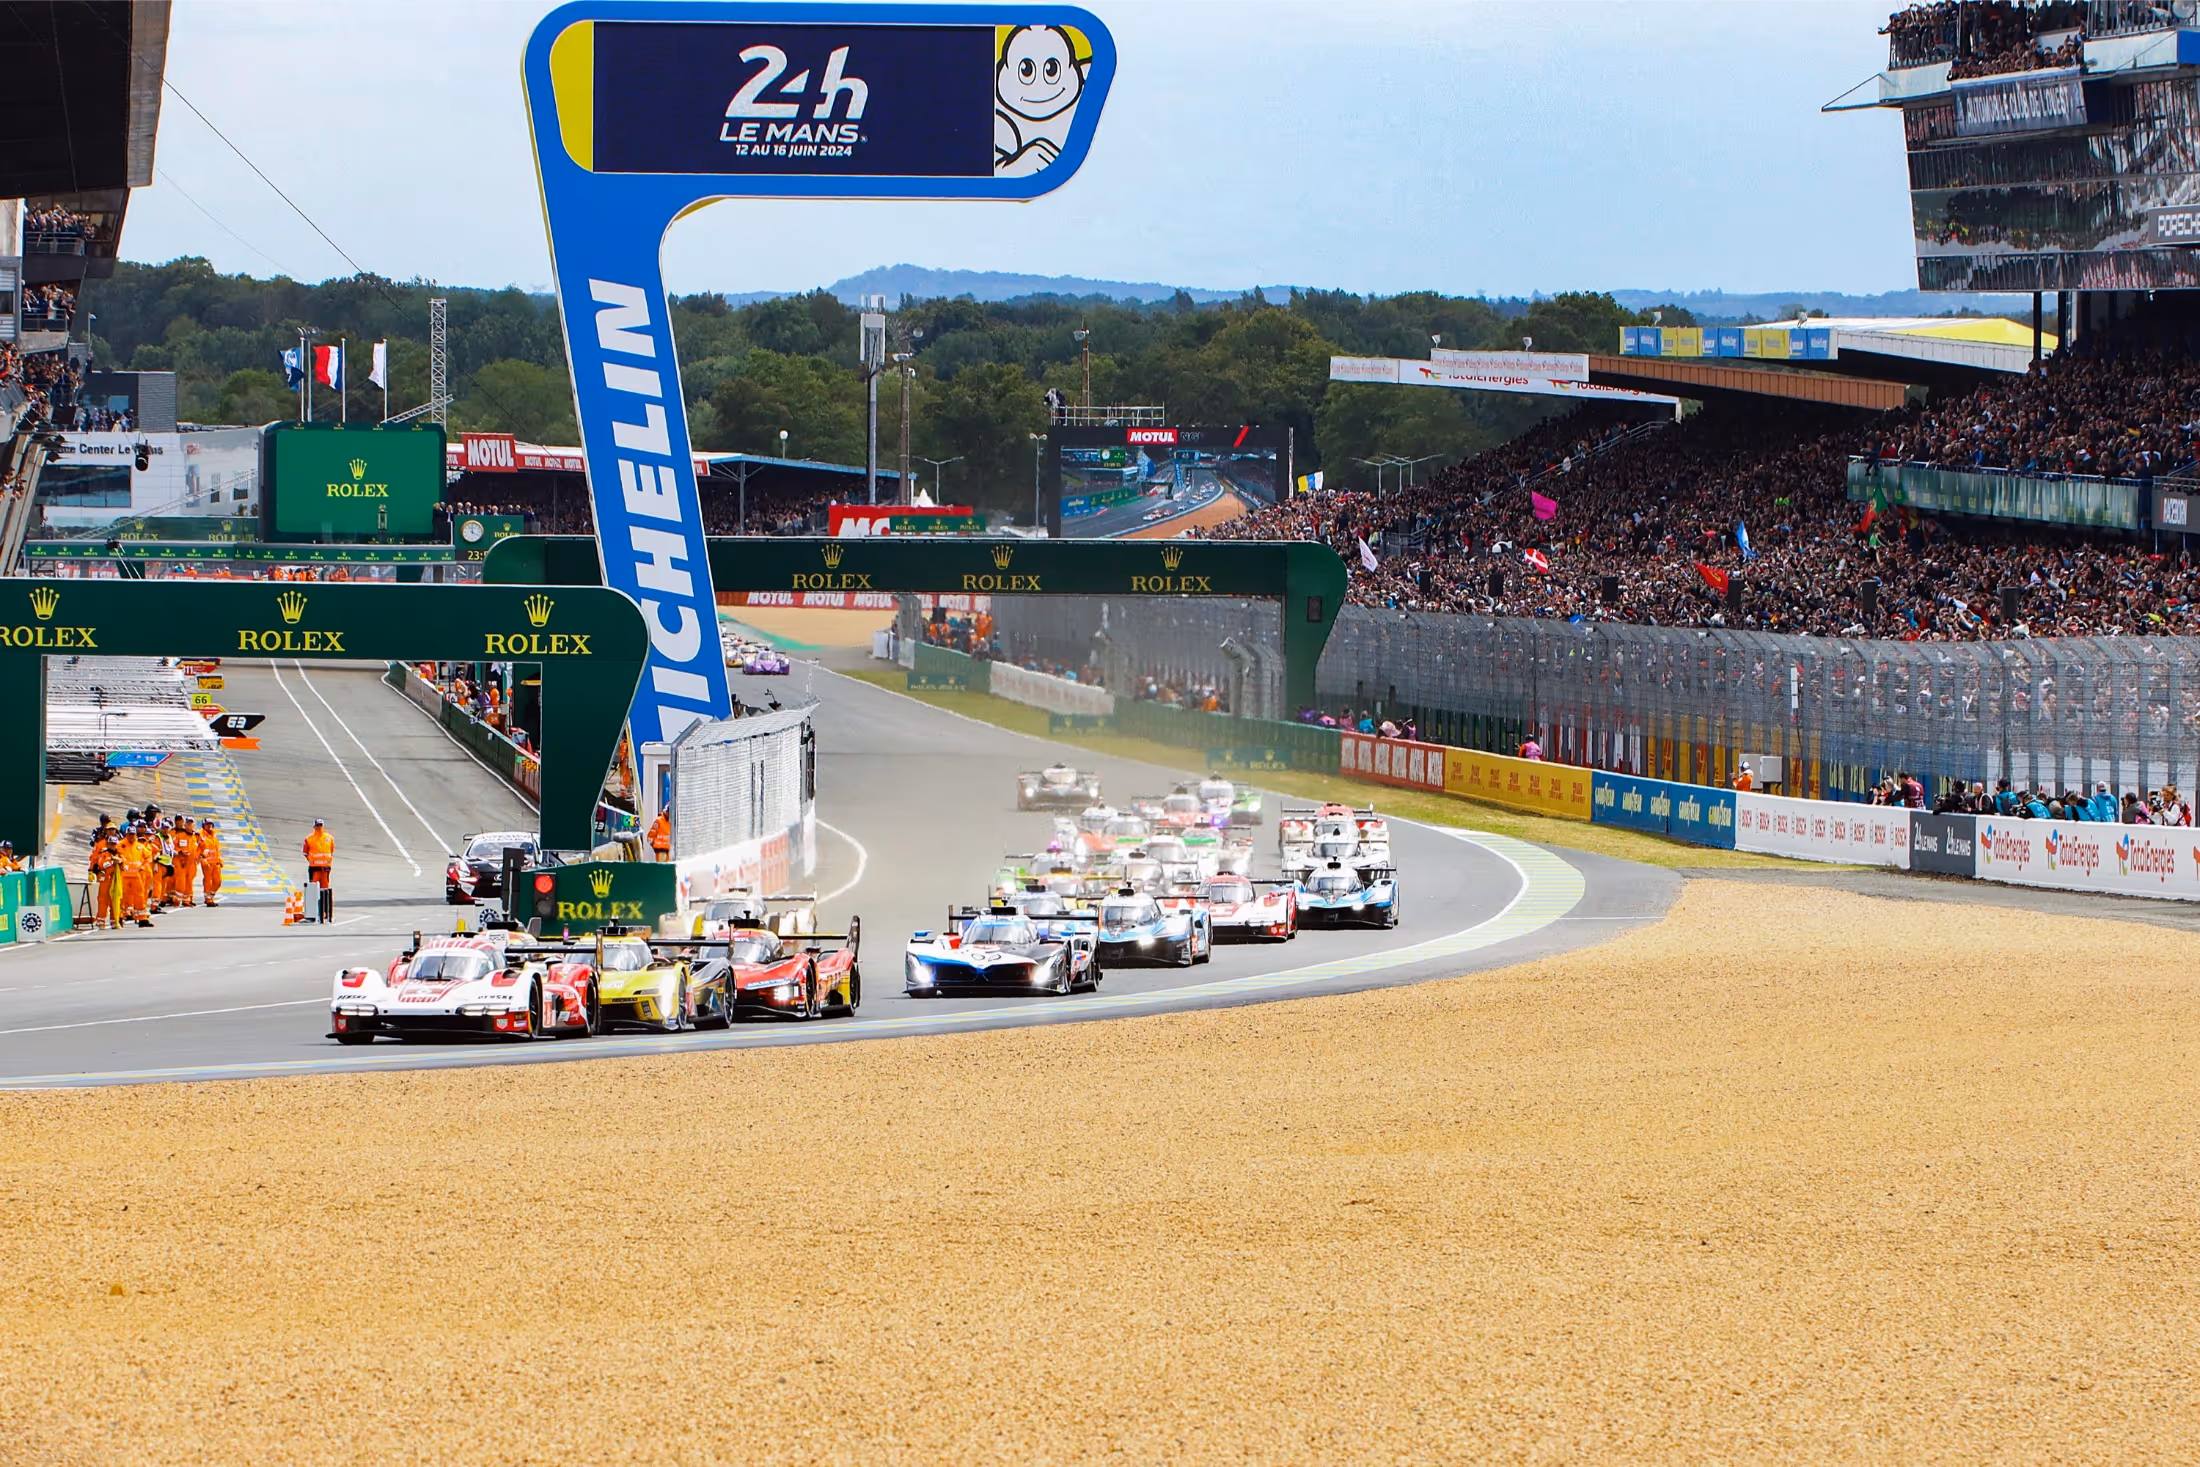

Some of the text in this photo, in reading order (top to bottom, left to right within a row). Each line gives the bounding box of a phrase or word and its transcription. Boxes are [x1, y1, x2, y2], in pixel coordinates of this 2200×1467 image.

[725, 46, 869, 118] 24h
[2010, 89, 2029, 120] CLUB
[720, 124, 760, 143] LE
[736, 145, 853, 158] 12 AU 16 JUIN 2024
[1130, 432, 1175, 442] MOTUL
[79, 444, 115, 455] Center
[118, 444, 131, 455] Le
[468, 439, 514, 467] MOTUL
[327, 483, 389, 497] ROLEX
[792, 574, 1212, 591] ROLEX ROLEX ROLEX
[747, 591, 793, 605] MOTUL
[854, 593, 892, 608] MOTUL
[0, 626, 592, 655] ROLEX ROLEX ROLEX
[195, 696, 207, 704] 66
[227, 716, 247, 729] 63
[1993, 830, 2175, 883] TotalEnergies TotalEnergies TotalEnergies
[557, 901, 643, 920] ROLEX
